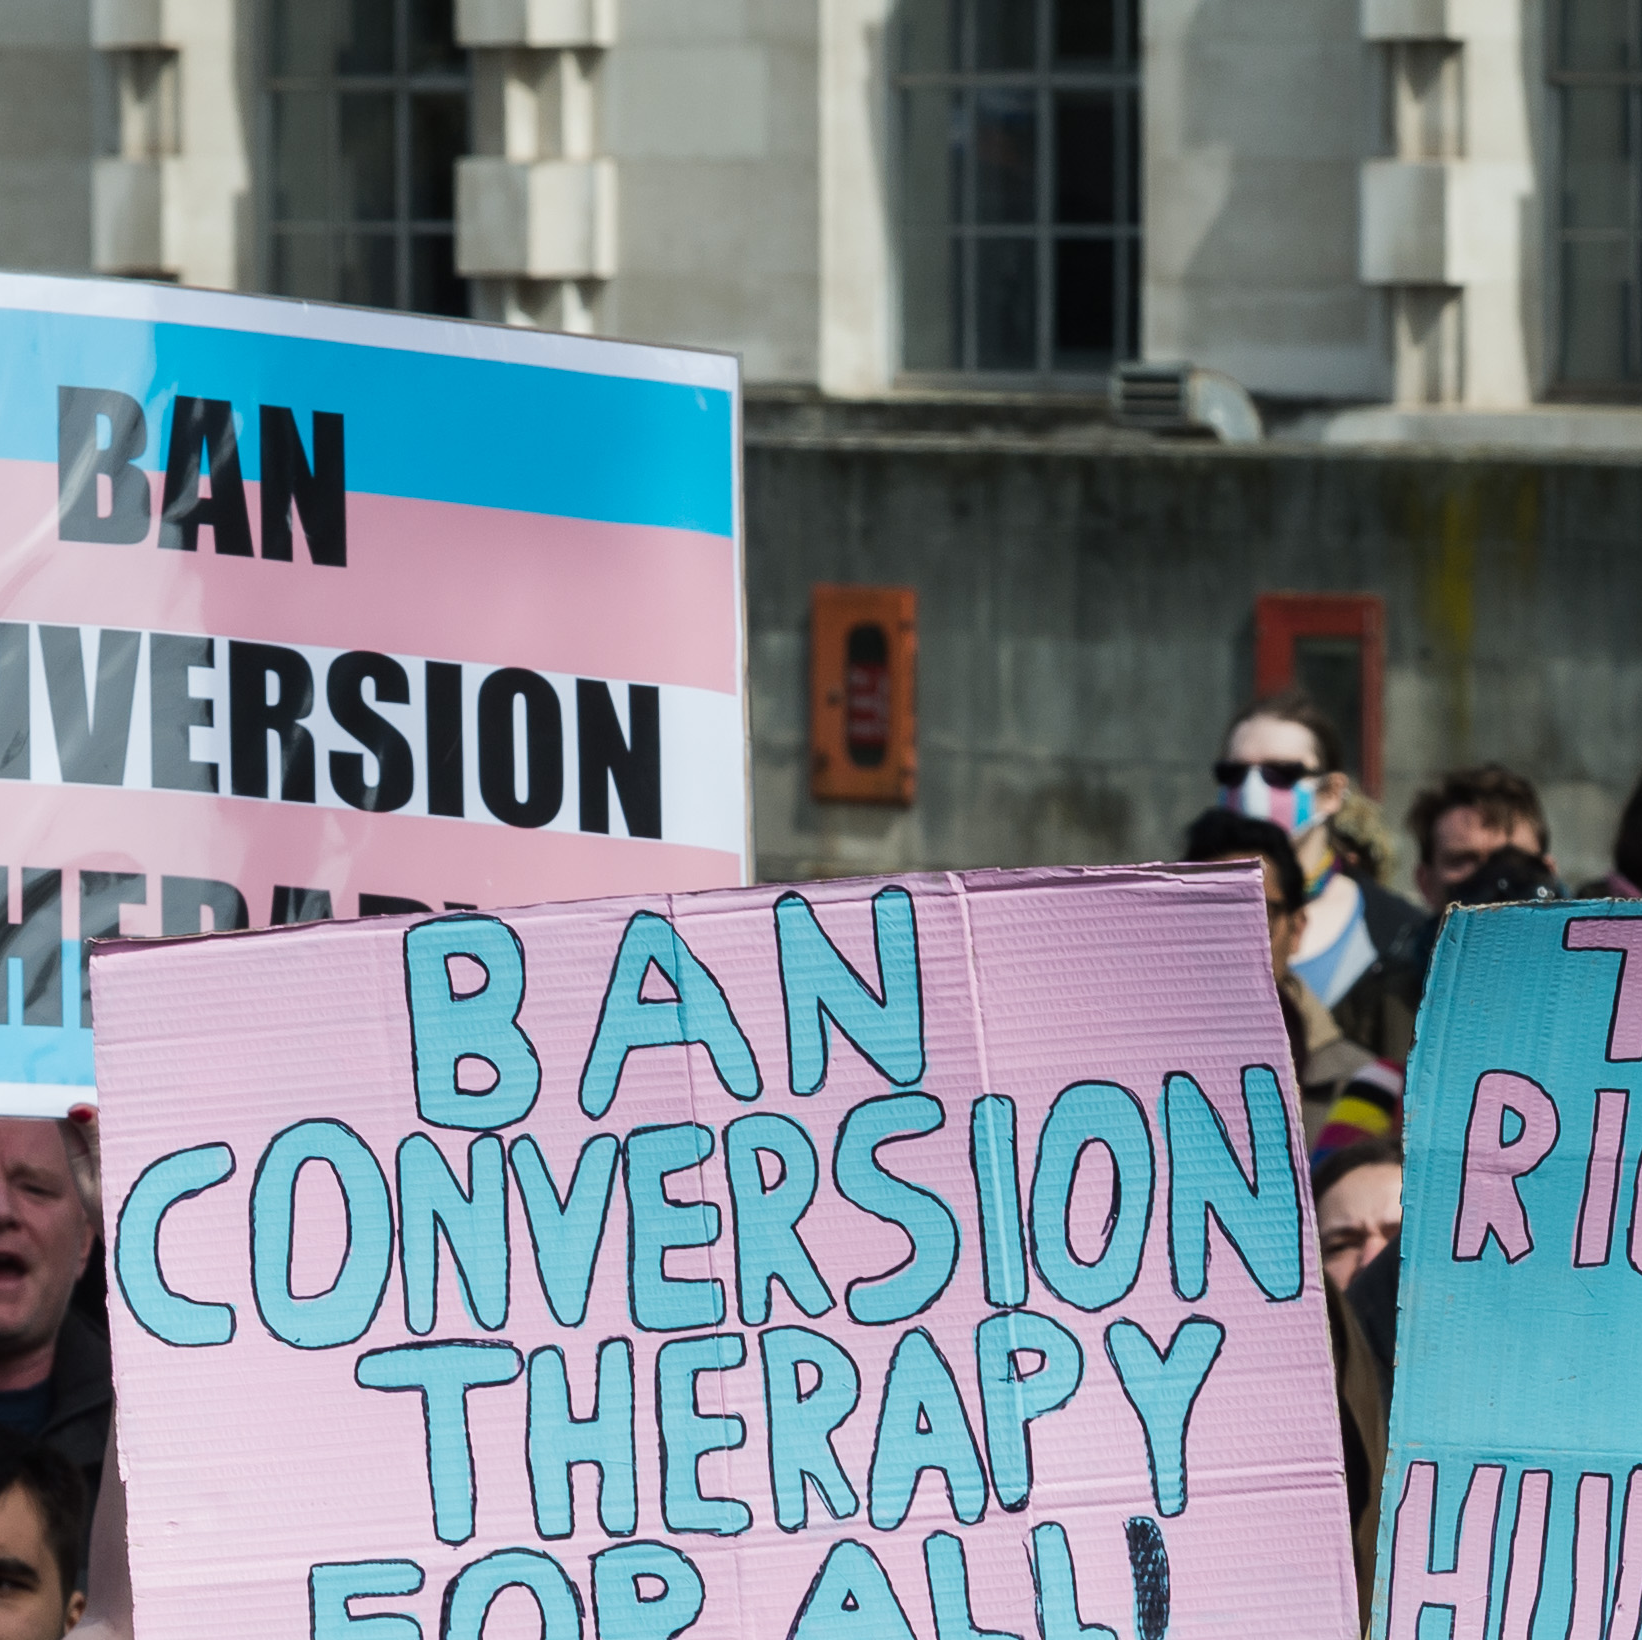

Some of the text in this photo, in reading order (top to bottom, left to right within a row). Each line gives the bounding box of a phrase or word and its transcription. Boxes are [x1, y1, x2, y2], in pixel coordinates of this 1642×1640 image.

[57, 385, 348, 569] BAN
[403, 885, 926, 1131] BAN
[114, 1062, 1303, 1349] CONVERSION
[354, 1310, 1226, 1545] THERAPY
